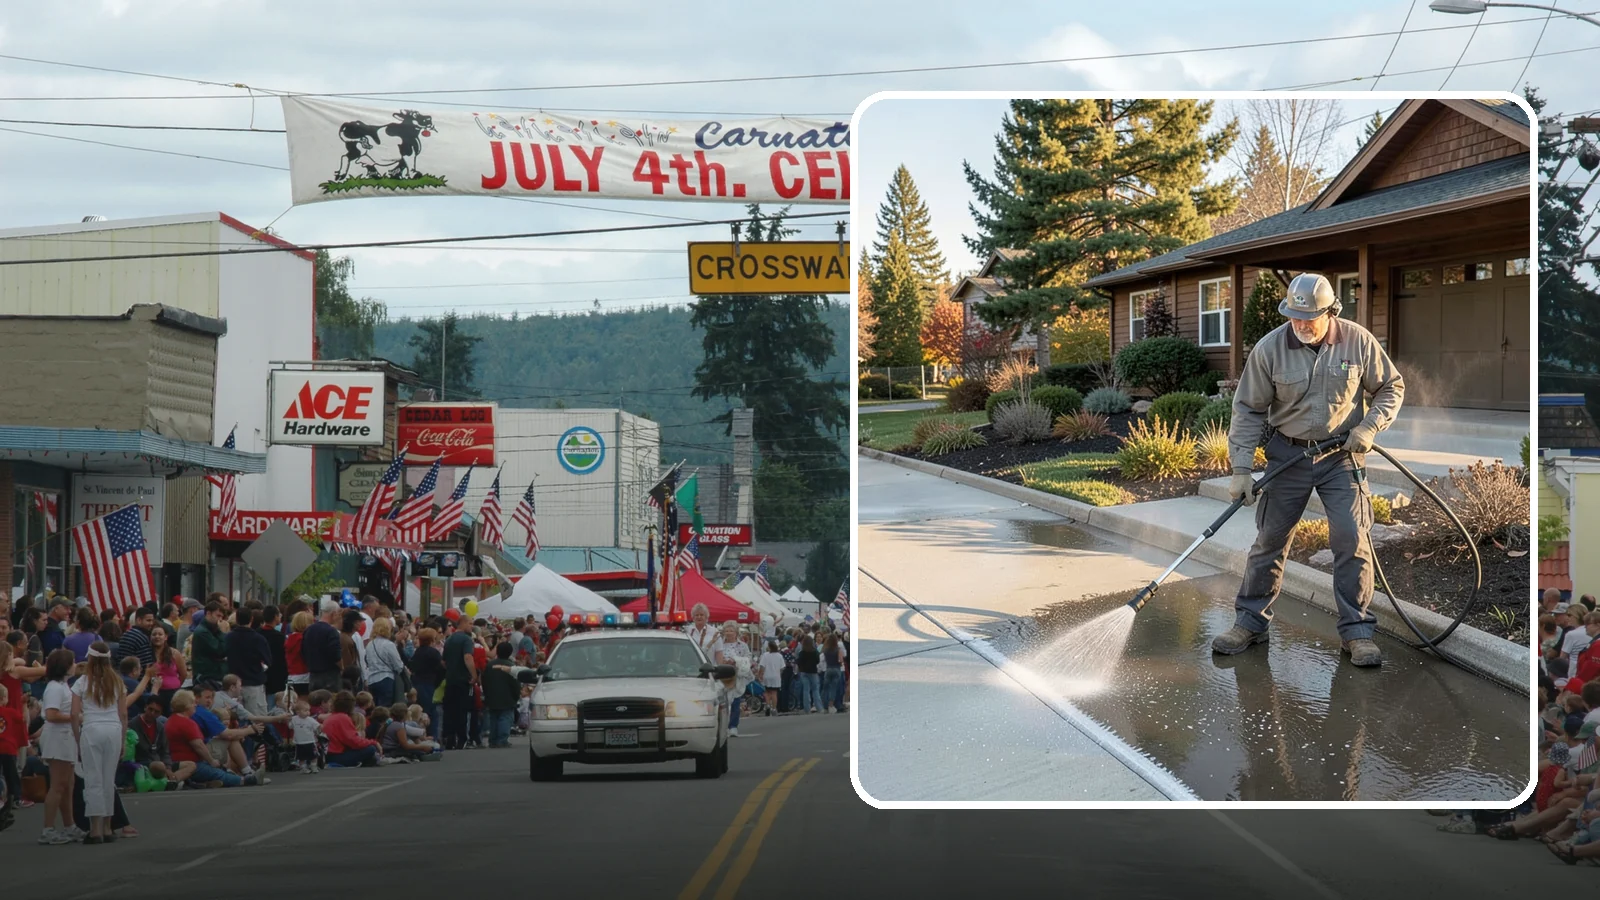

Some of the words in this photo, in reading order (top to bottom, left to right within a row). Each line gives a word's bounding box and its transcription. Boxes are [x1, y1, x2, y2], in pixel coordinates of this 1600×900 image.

[481, 141, 605, 192] JULY
[632, 150, 746, 198] 4th.
[697, 254, 850, 280] CROSSWA
[283, 380, 373, 420] ACE
[405, 409, 452, 422] CEDAR
[461, 410, 485, 421] LOG
[283, 421, 371, 436] Hardware
[416, 428, 477, 447] Coca-Cola
[83, 485, 94, 494] St.
[96, 486, 124, 495] Vincent
[126, 486, 136, 495] de
[138, 486, 155, 495] Paul
[688, 526, 741, 535] CRNATION
[699, 535, 730, 543] GLASS
